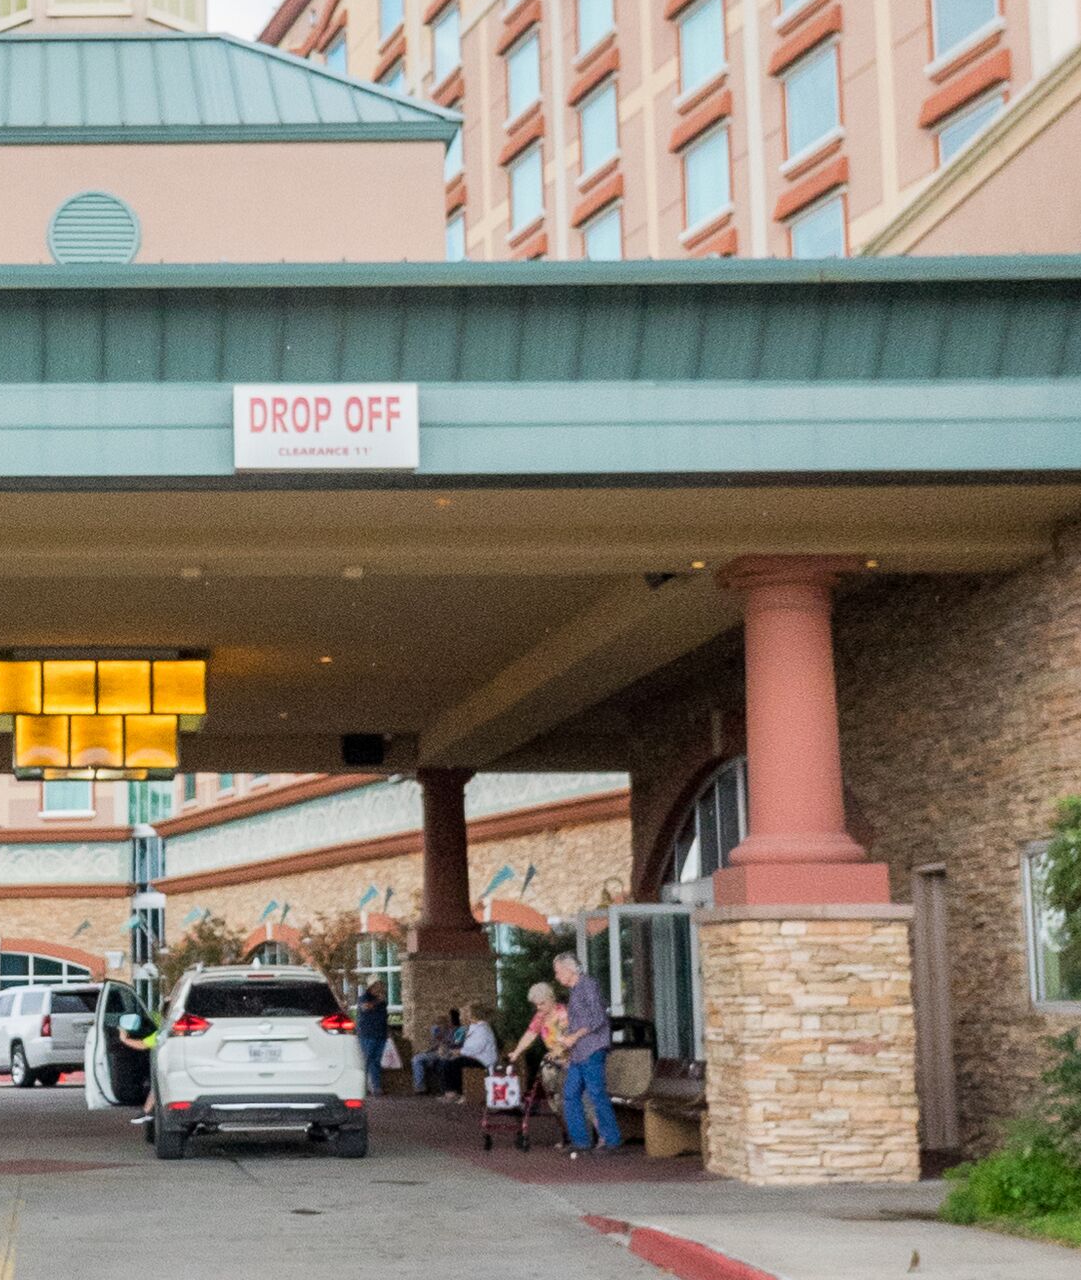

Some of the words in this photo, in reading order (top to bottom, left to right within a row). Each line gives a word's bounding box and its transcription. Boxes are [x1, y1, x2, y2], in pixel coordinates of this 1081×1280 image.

[250, 397, 332, 433] DROP
[345, 397, 401, 433] OFF
[278, 447, 349, 456] CLEARANCE
